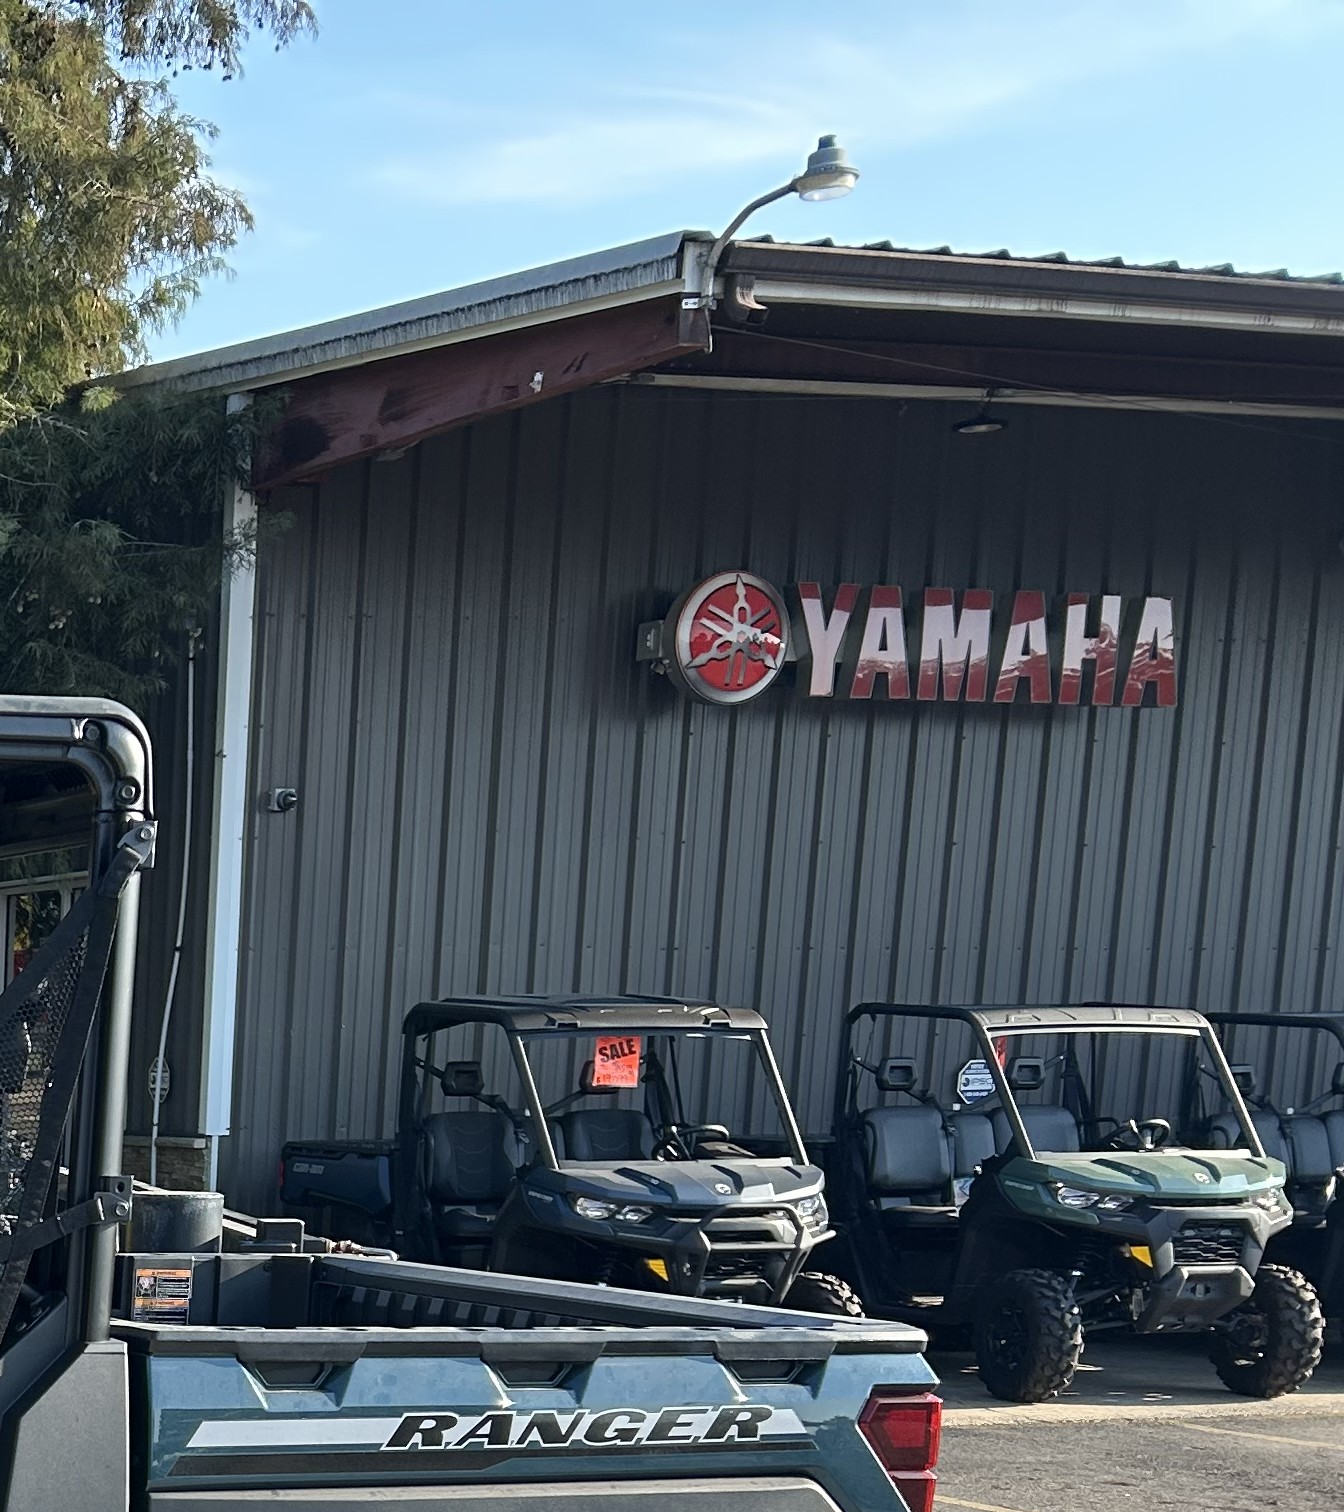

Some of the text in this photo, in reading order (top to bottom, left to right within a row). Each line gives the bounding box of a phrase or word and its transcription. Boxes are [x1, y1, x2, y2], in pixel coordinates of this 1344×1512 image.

[798, 581, 1178, 707] YAMAHA
[598, 1038, 637, 1062] SALE
[380, 1405, 774, 1451] RANGER
